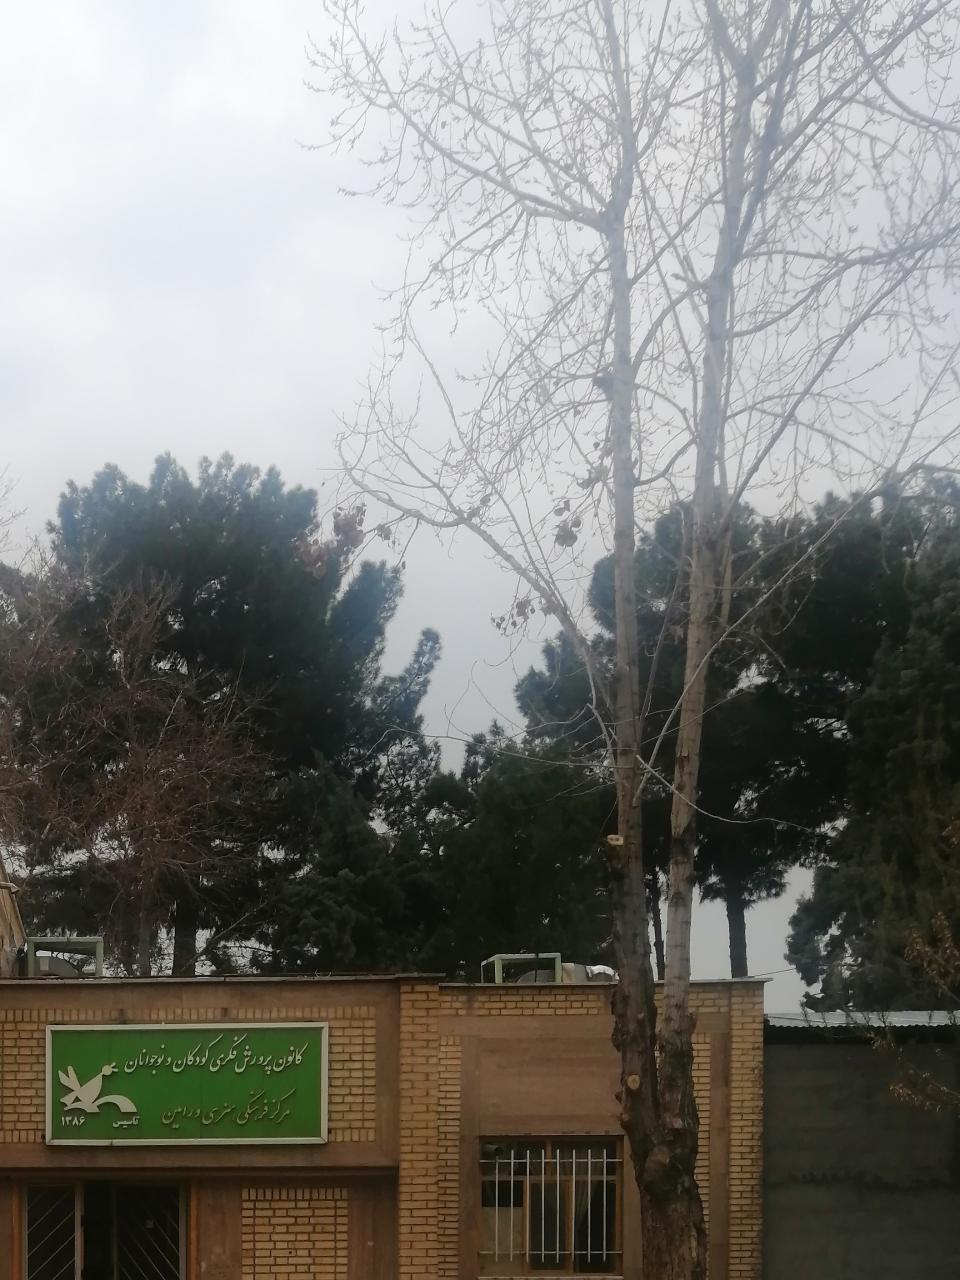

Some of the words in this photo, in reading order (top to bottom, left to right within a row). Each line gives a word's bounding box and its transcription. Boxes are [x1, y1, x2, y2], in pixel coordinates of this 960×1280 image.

[123, 1043, 165, 1075] نوجوانان
[165, 1056, 172, 1066] و
[171, 1033, 223, 1073] کودکان
[209, 1033, 247, 1072] فکری
[234, 1044, 272, 1075] پرورش
[272, 1040, 309, 1073] کانون
[160, 1105, 201, 1129] ورامین
[201, 1103, 237, 1125] هنری
[235, 1089, 269, 1125] فرهنگی
[269, 1088, 297, 1124] مرکز
[60, 1116, 86, 1128] ۱۳۸۶
[112, 1115, 140, 1129] تاسیس
